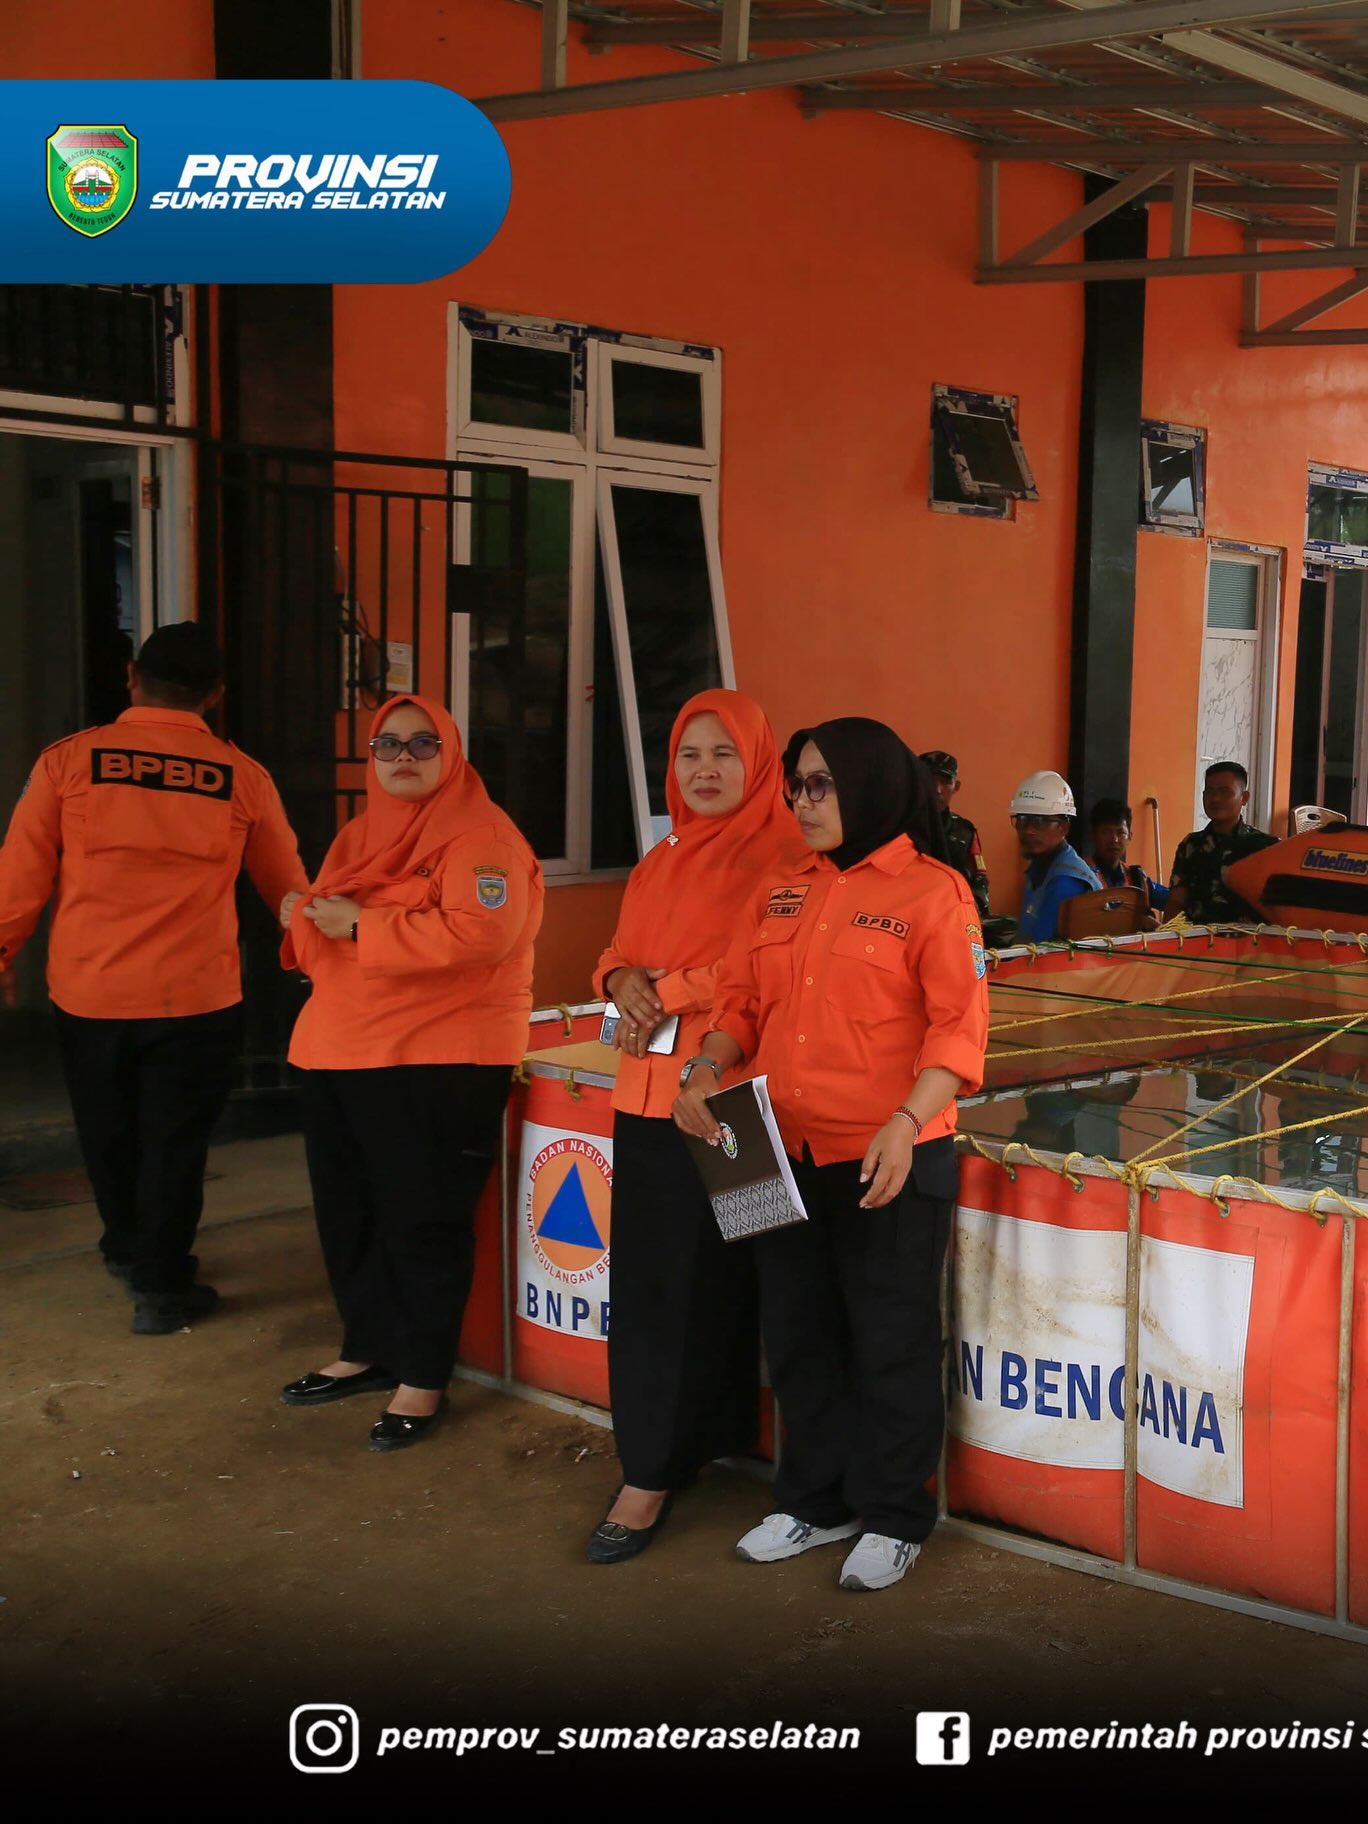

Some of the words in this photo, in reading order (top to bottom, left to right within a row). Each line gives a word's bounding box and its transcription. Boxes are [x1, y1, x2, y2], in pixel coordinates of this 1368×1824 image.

[100, 752, 225, 793] BPBD
[1304, 849, 1368, 874] bluelines
[856, 914, 906, 935] BPBD
[529, 1141, 566, 1181] BADAN
[569, 1140, 614, 1187] NASIONA
[526, 1193, 594, 1285] PENANGGULANGAN
[1000, 1350, 1225, 1454] BENCANA
